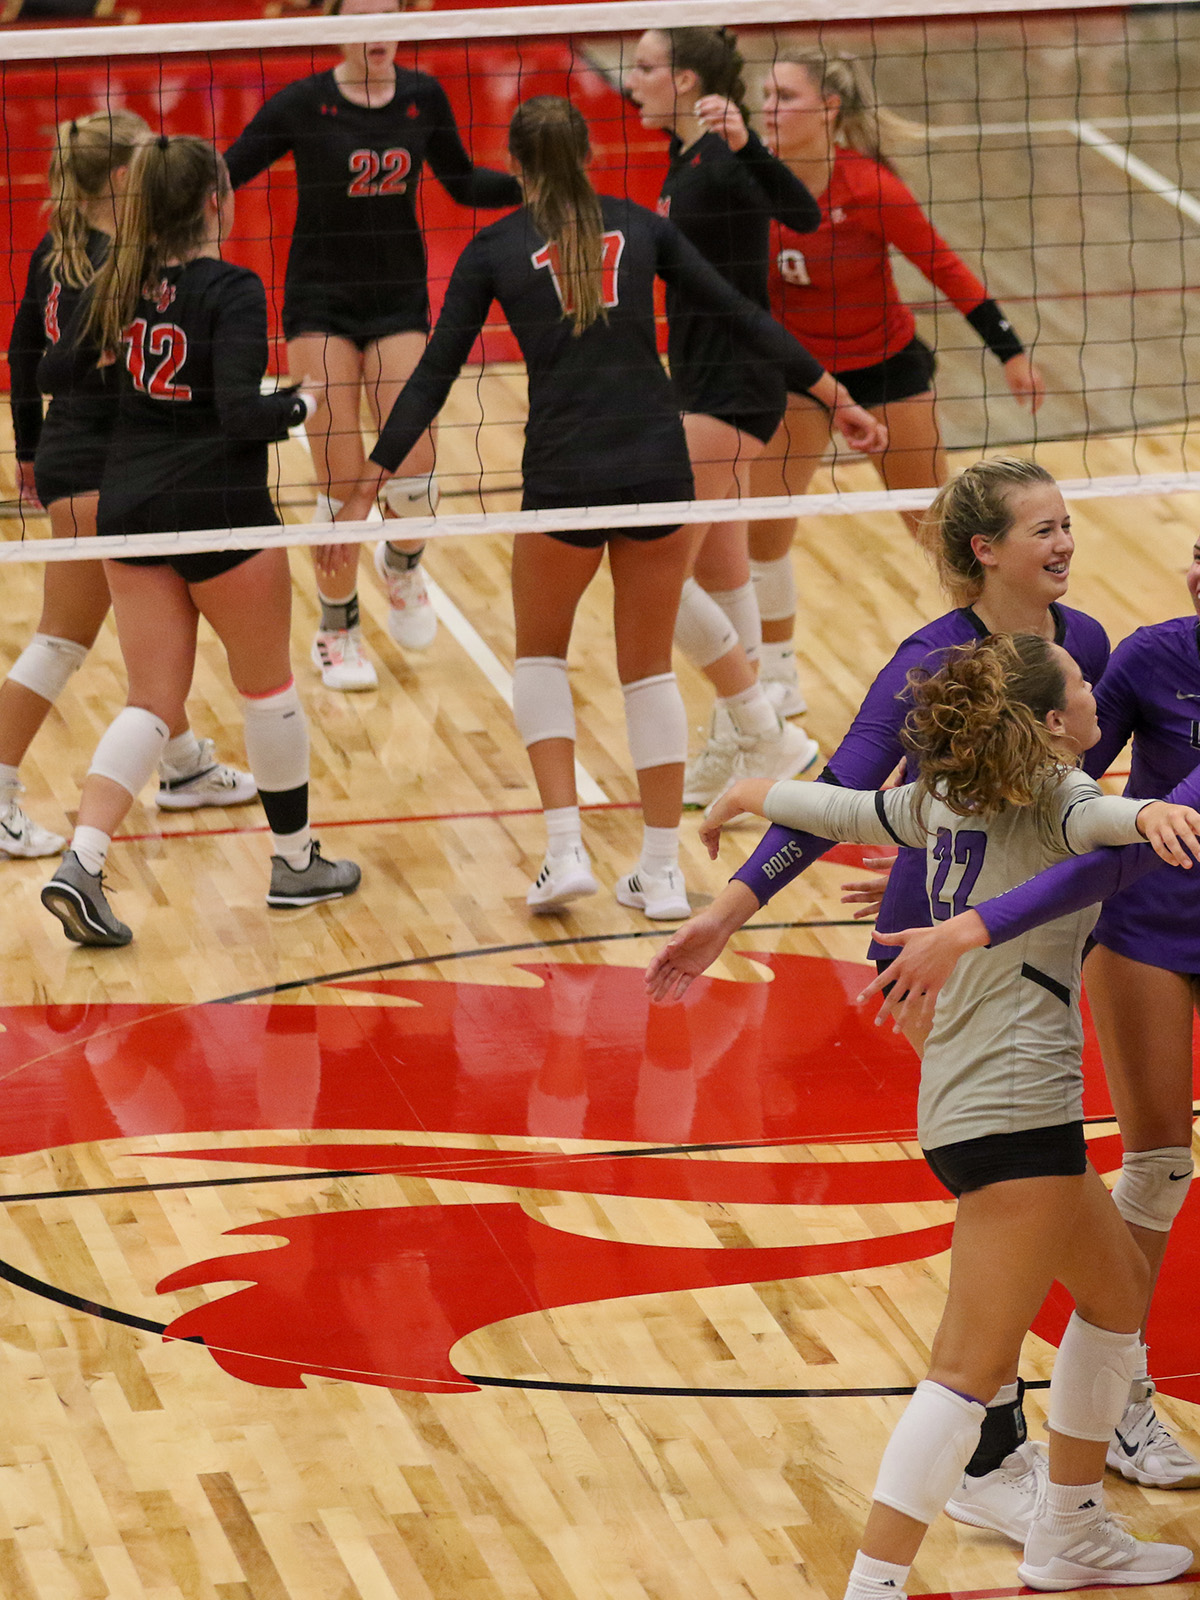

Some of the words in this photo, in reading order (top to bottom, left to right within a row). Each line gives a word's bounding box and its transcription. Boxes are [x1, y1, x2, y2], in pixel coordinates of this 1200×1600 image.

[347, 147, 411, 197] 22
[119, 317, 192, 400] 12
[761, 840, 803, 880] BOLTS
[930, 826, 988, 921] 22
